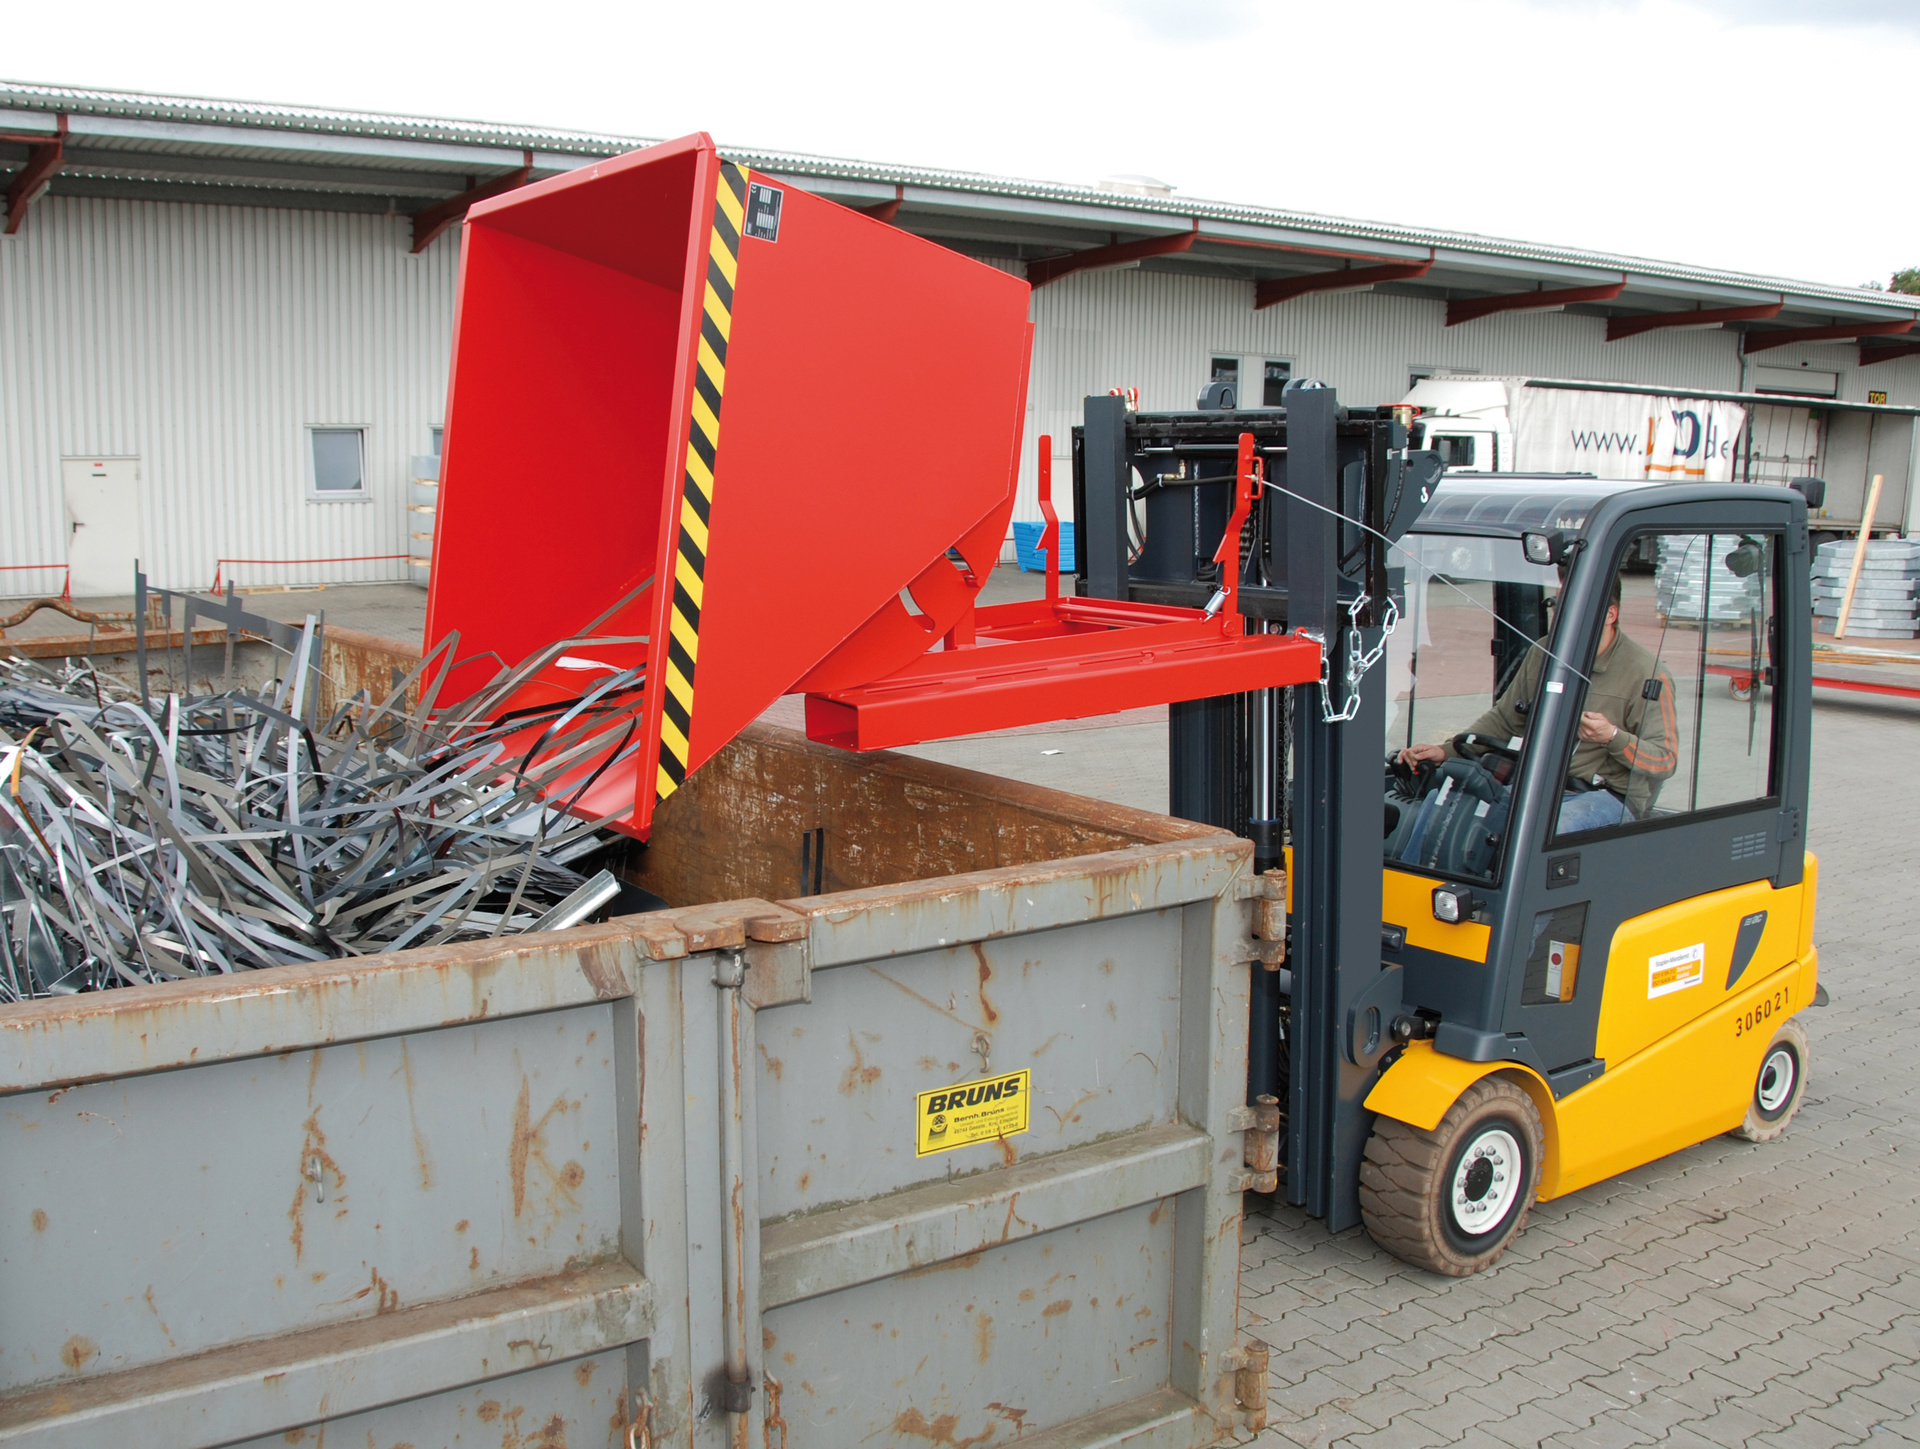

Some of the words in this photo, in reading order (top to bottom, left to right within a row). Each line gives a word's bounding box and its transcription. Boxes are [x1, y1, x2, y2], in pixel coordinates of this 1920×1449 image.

[1869, 392, 1886, 405] TOR
[1735, 986, 1789, 1038] 306021
[927, 1077, 1020, 1115] BRUNS
[981, 1107, 1005, 1117] Bruns
